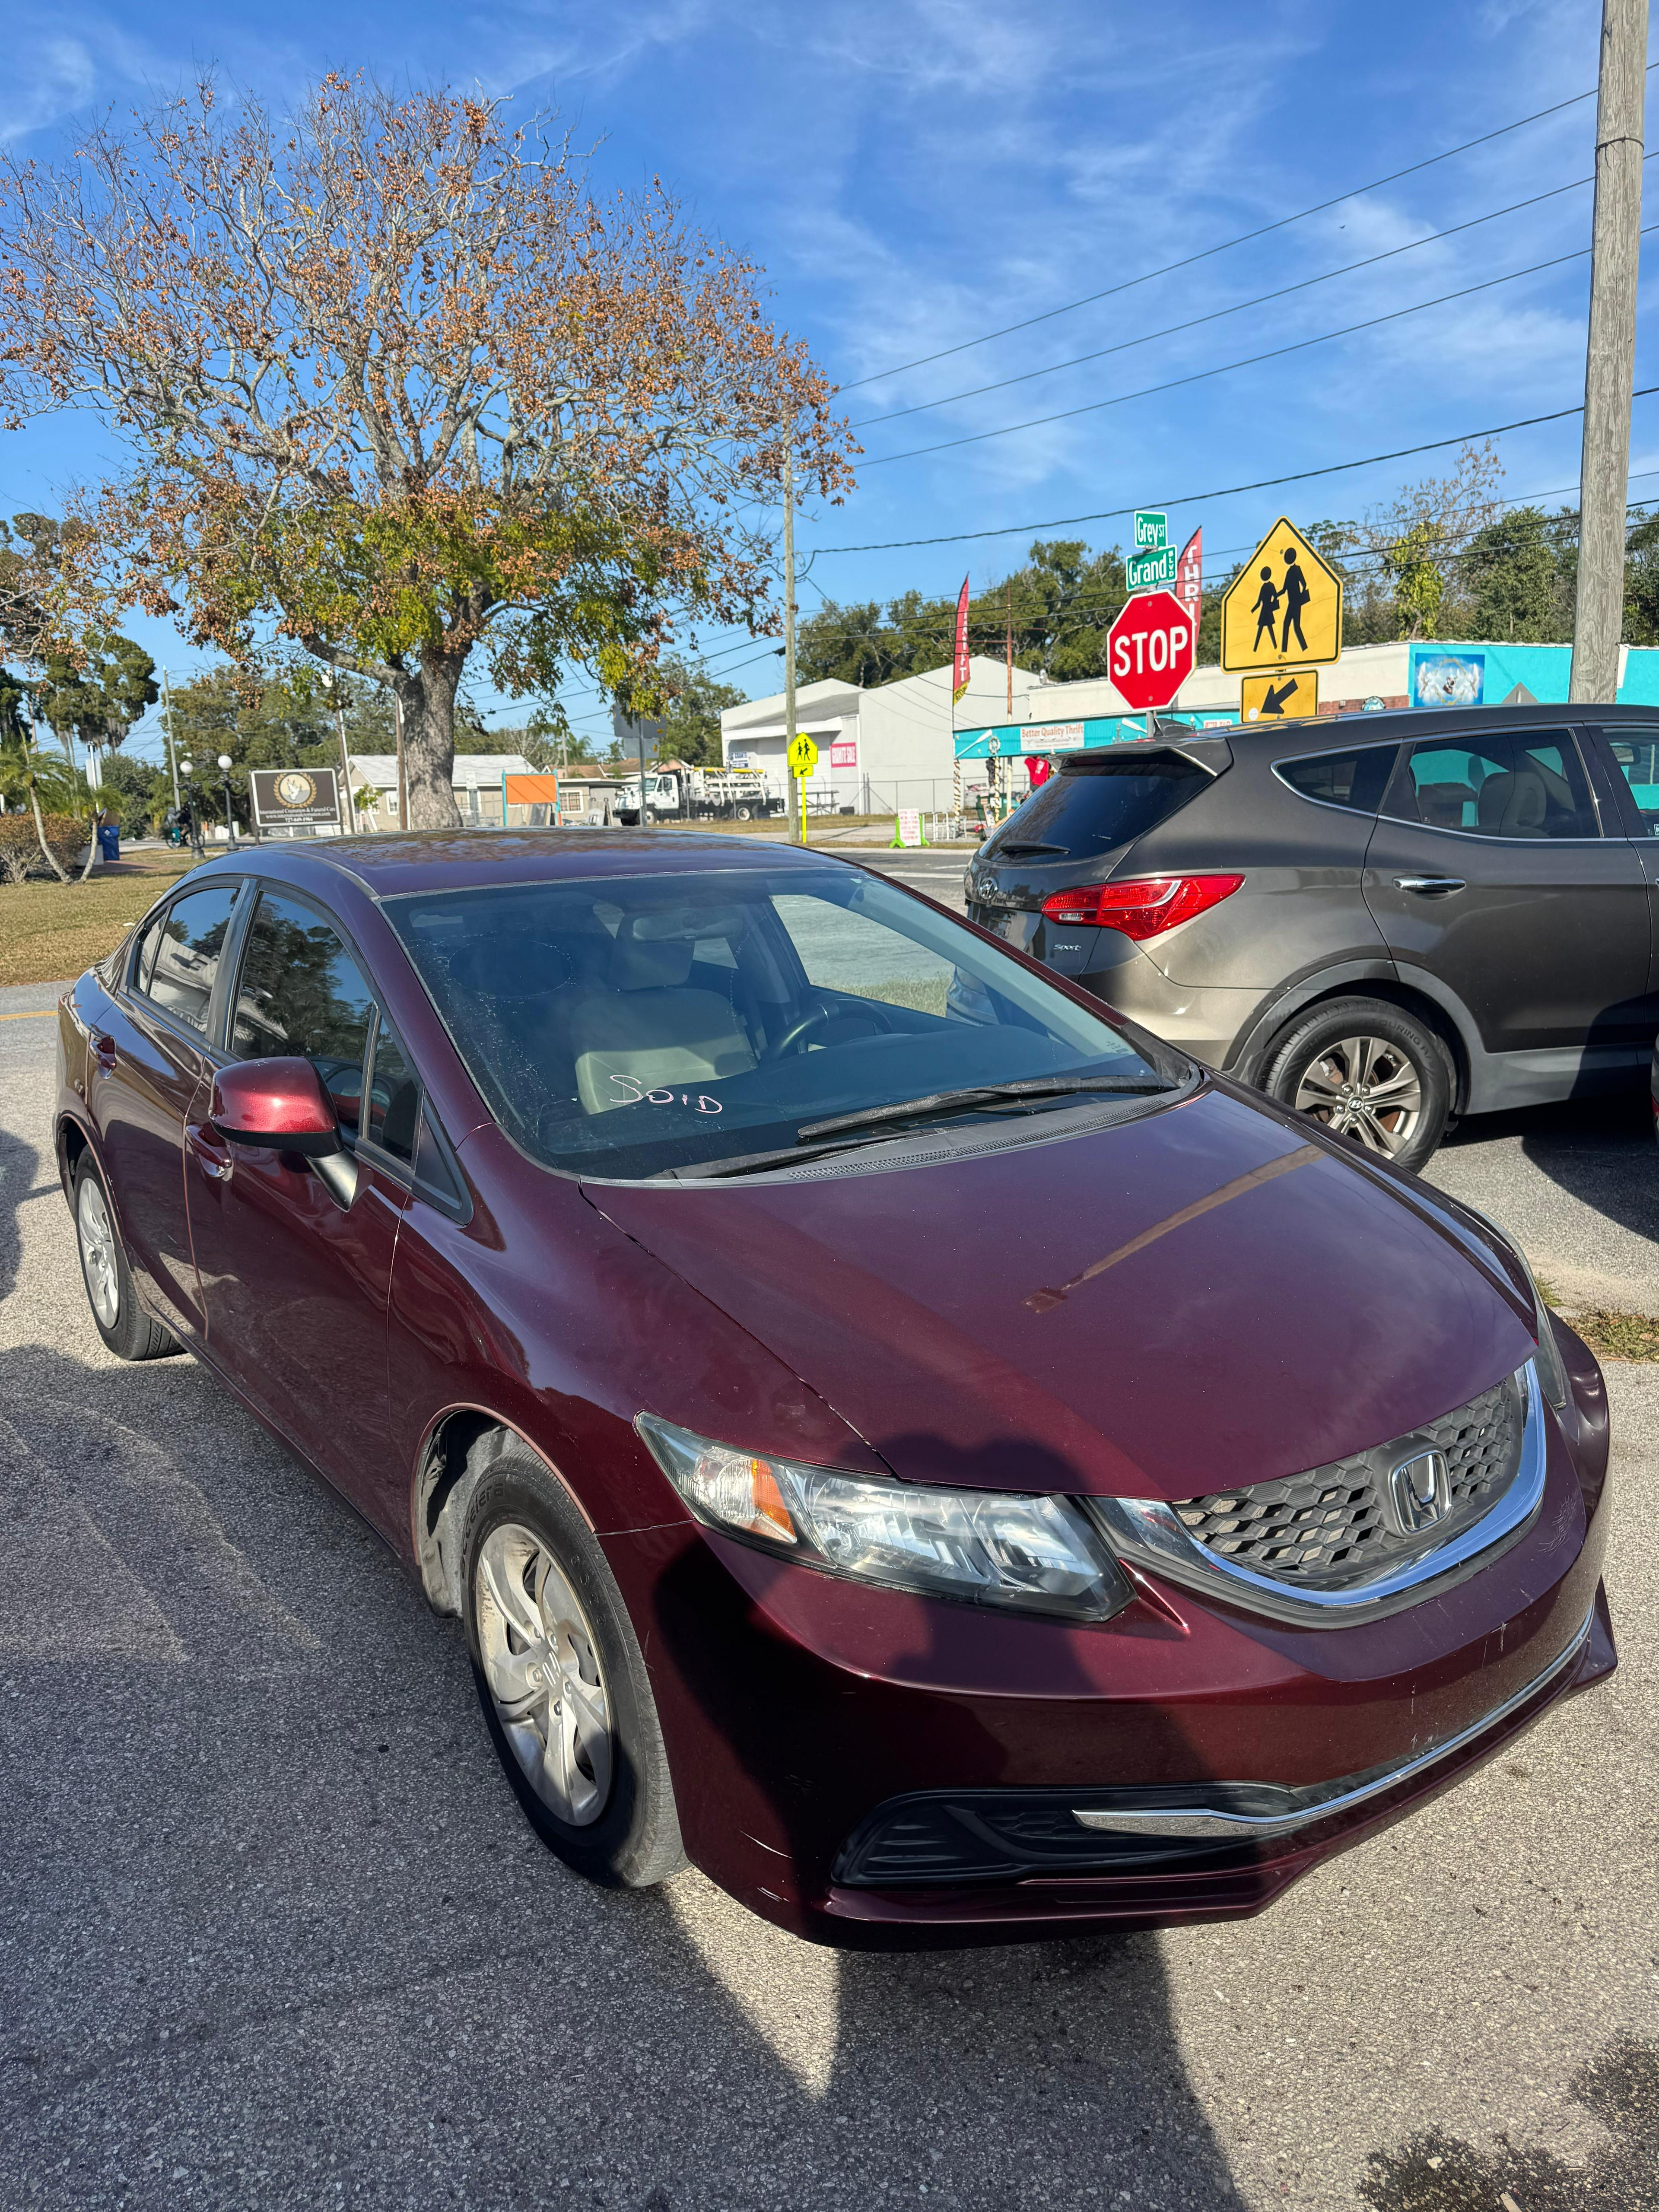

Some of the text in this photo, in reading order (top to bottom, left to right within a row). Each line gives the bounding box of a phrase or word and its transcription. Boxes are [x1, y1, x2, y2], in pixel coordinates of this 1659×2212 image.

[1137, 516, 1165, 547] Grey ST
[1129, 553, 1166, 585] Grand
[1183, 545, 1200, 622] THRI
[1114, 625, 1188, 677] STOP
[1021, 723, 1083, 738] Better Quality Thrift
[1372, 1018, 1420, 1045] TOURING
